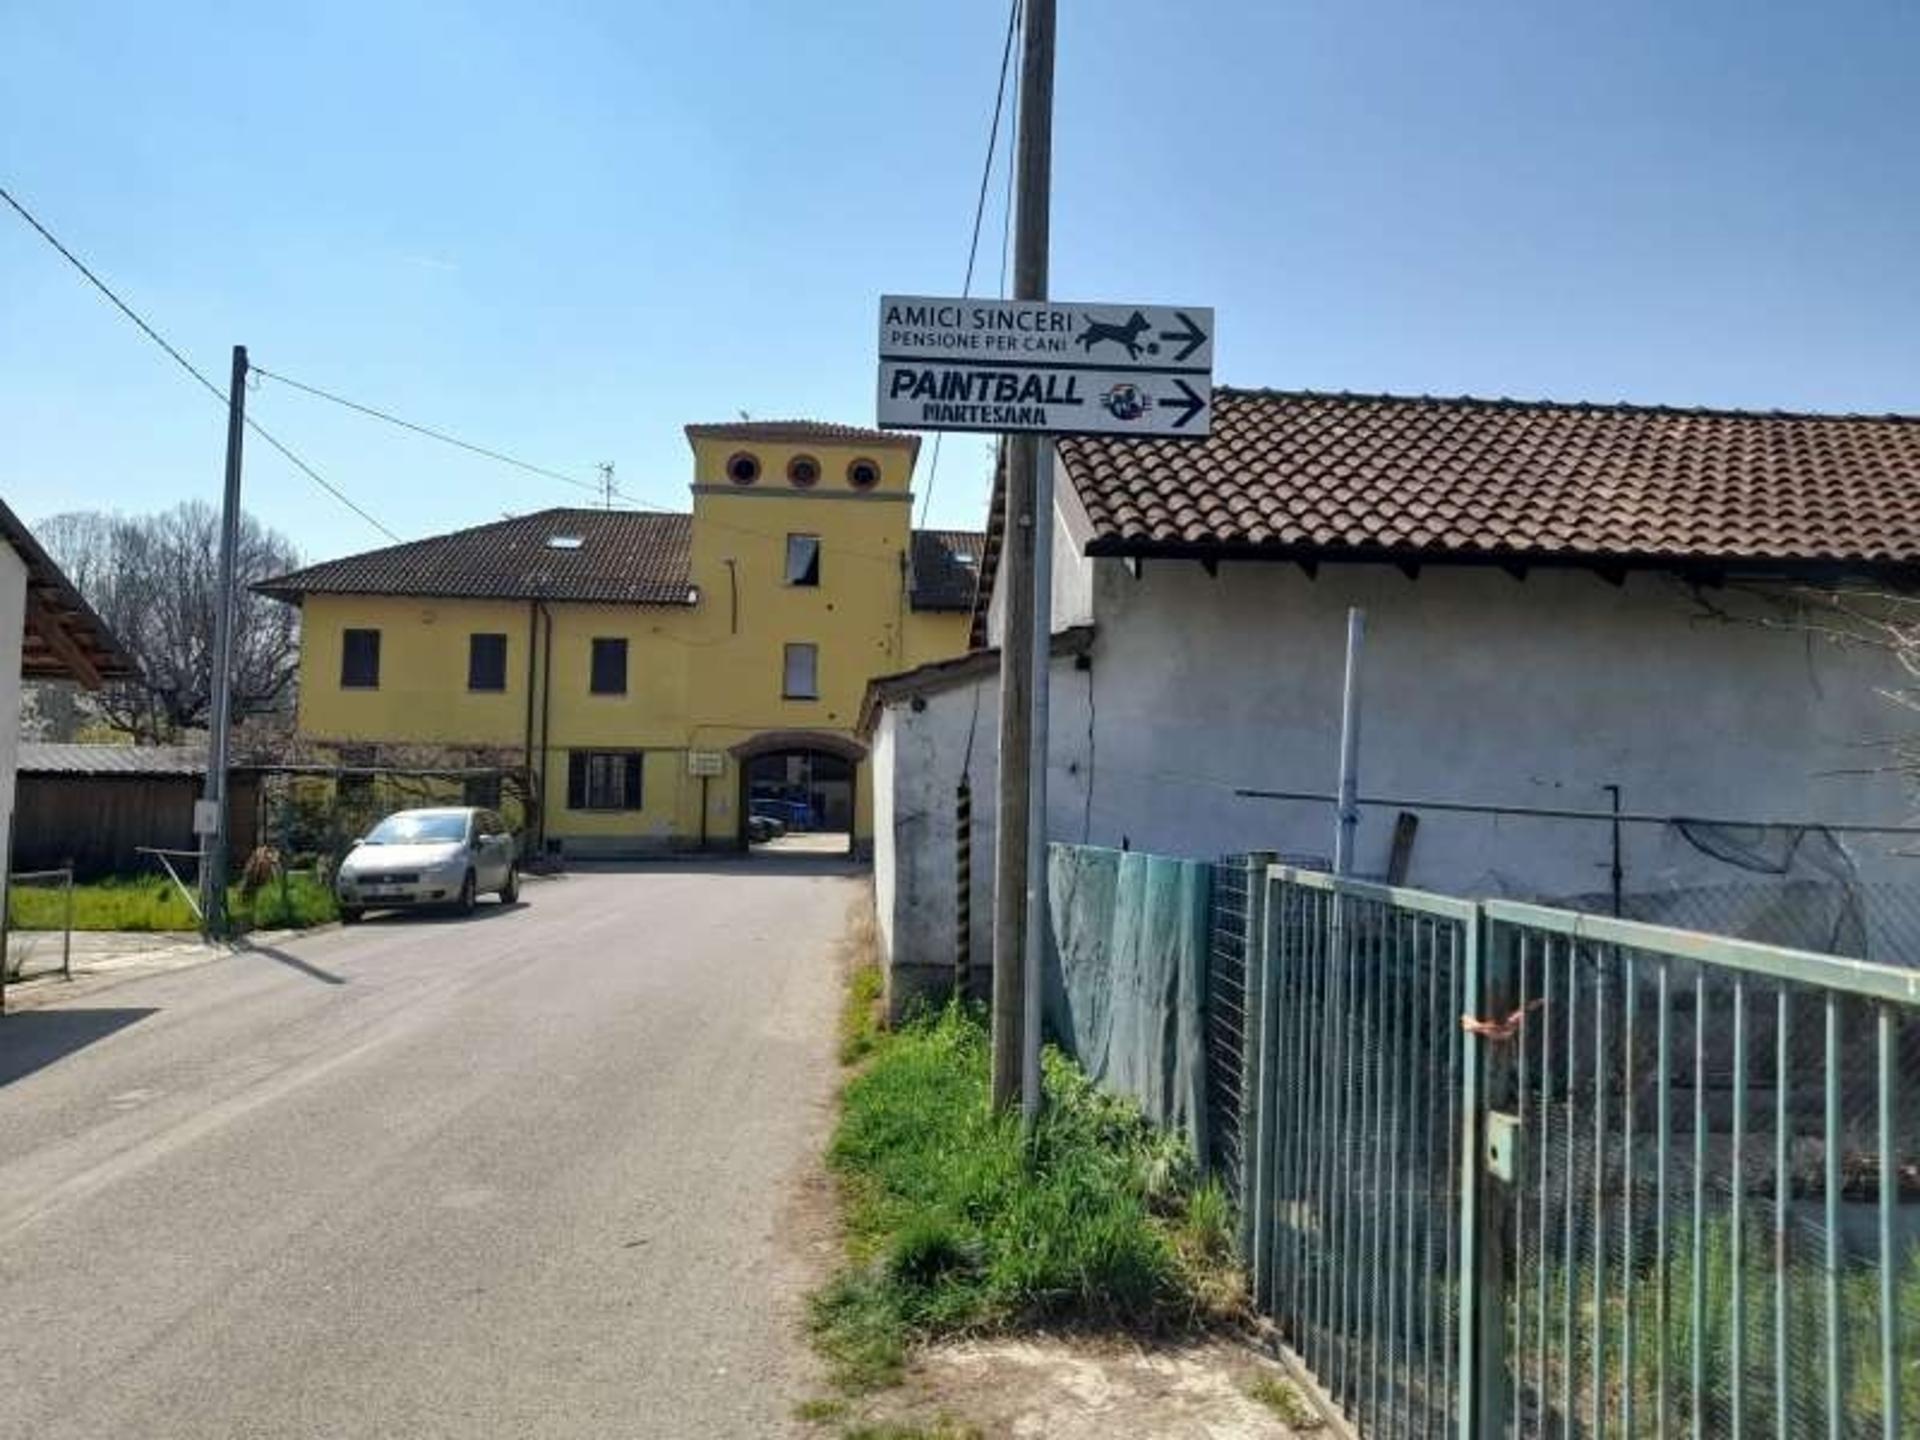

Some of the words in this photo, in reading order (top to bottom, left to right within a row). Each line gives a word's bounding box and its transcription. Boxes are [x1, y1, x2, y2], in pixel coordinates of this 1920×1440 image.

[886, 307, 961, 327] AMICI
[973, 309, 1071, 332] SINCERI
[891, 331, 979, 349] PENSIONE
[986, 335, 1017, 351] PER
[1023, 336, 1067, 352] CANI
[890, 369, 1084, 405] PAINTBALL
[922, 404, 1047, 425] MARTESANA
